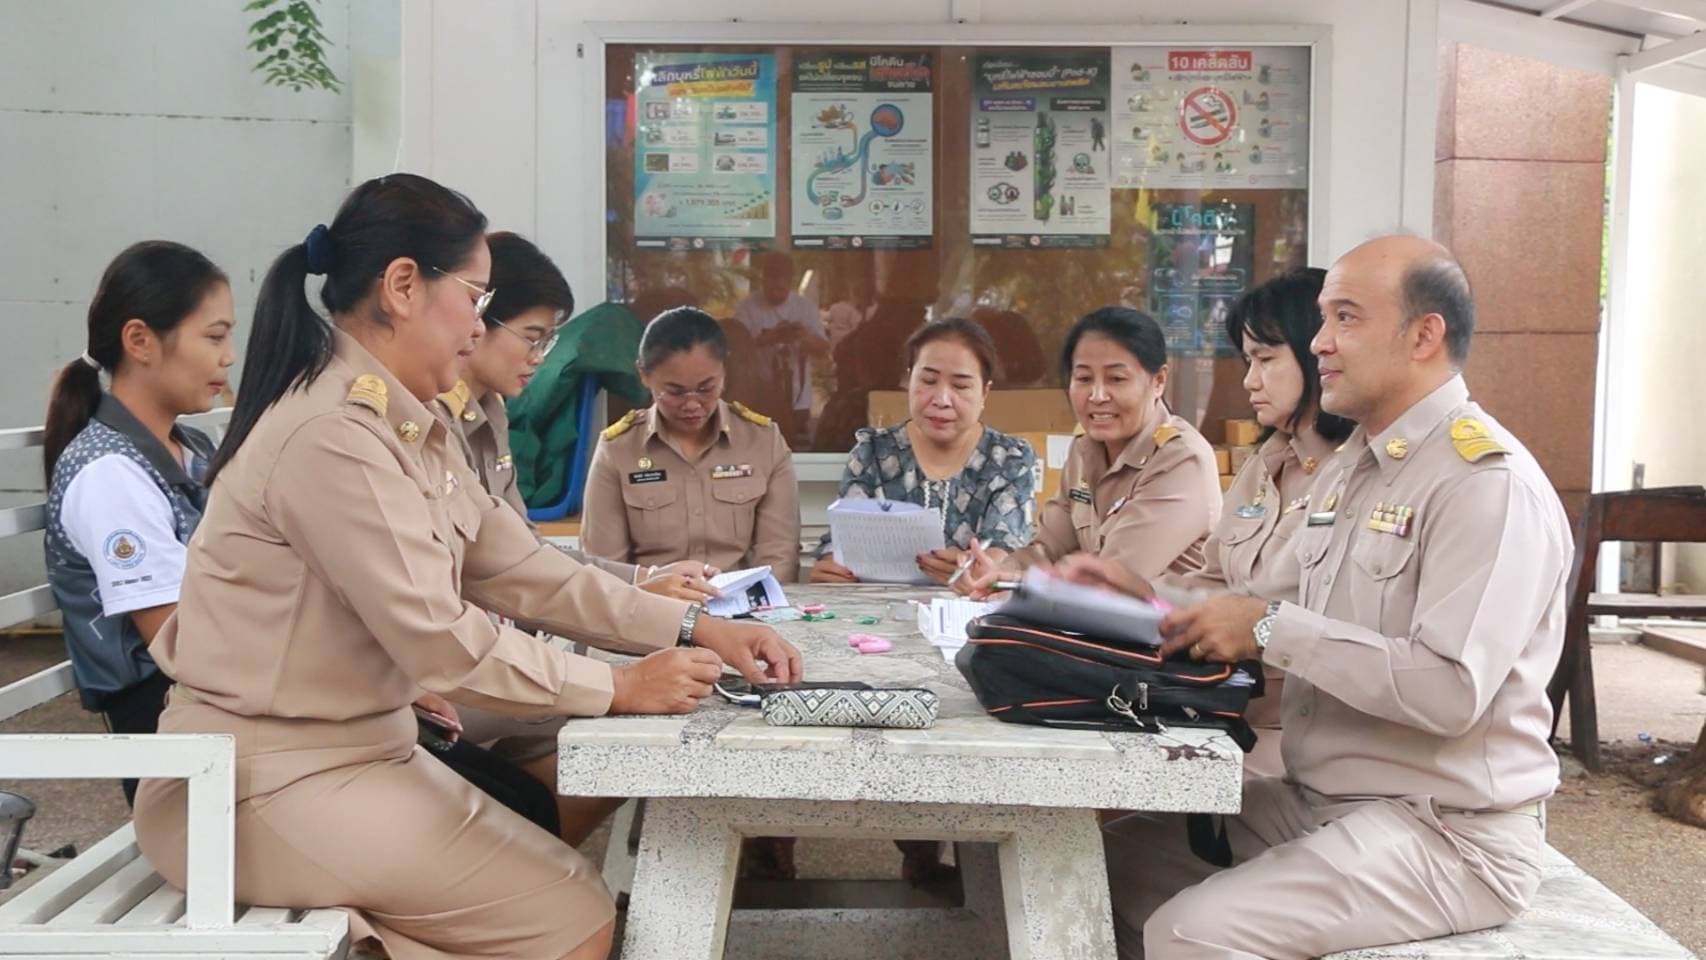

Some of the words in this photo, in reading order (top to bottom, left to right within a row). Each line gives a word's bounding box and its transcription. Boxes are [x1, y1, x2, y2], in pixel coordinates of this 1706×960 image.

[1171, 57, 1190, 69] 10
[1193, 52, 1248, 69] เคล็ดลับ
